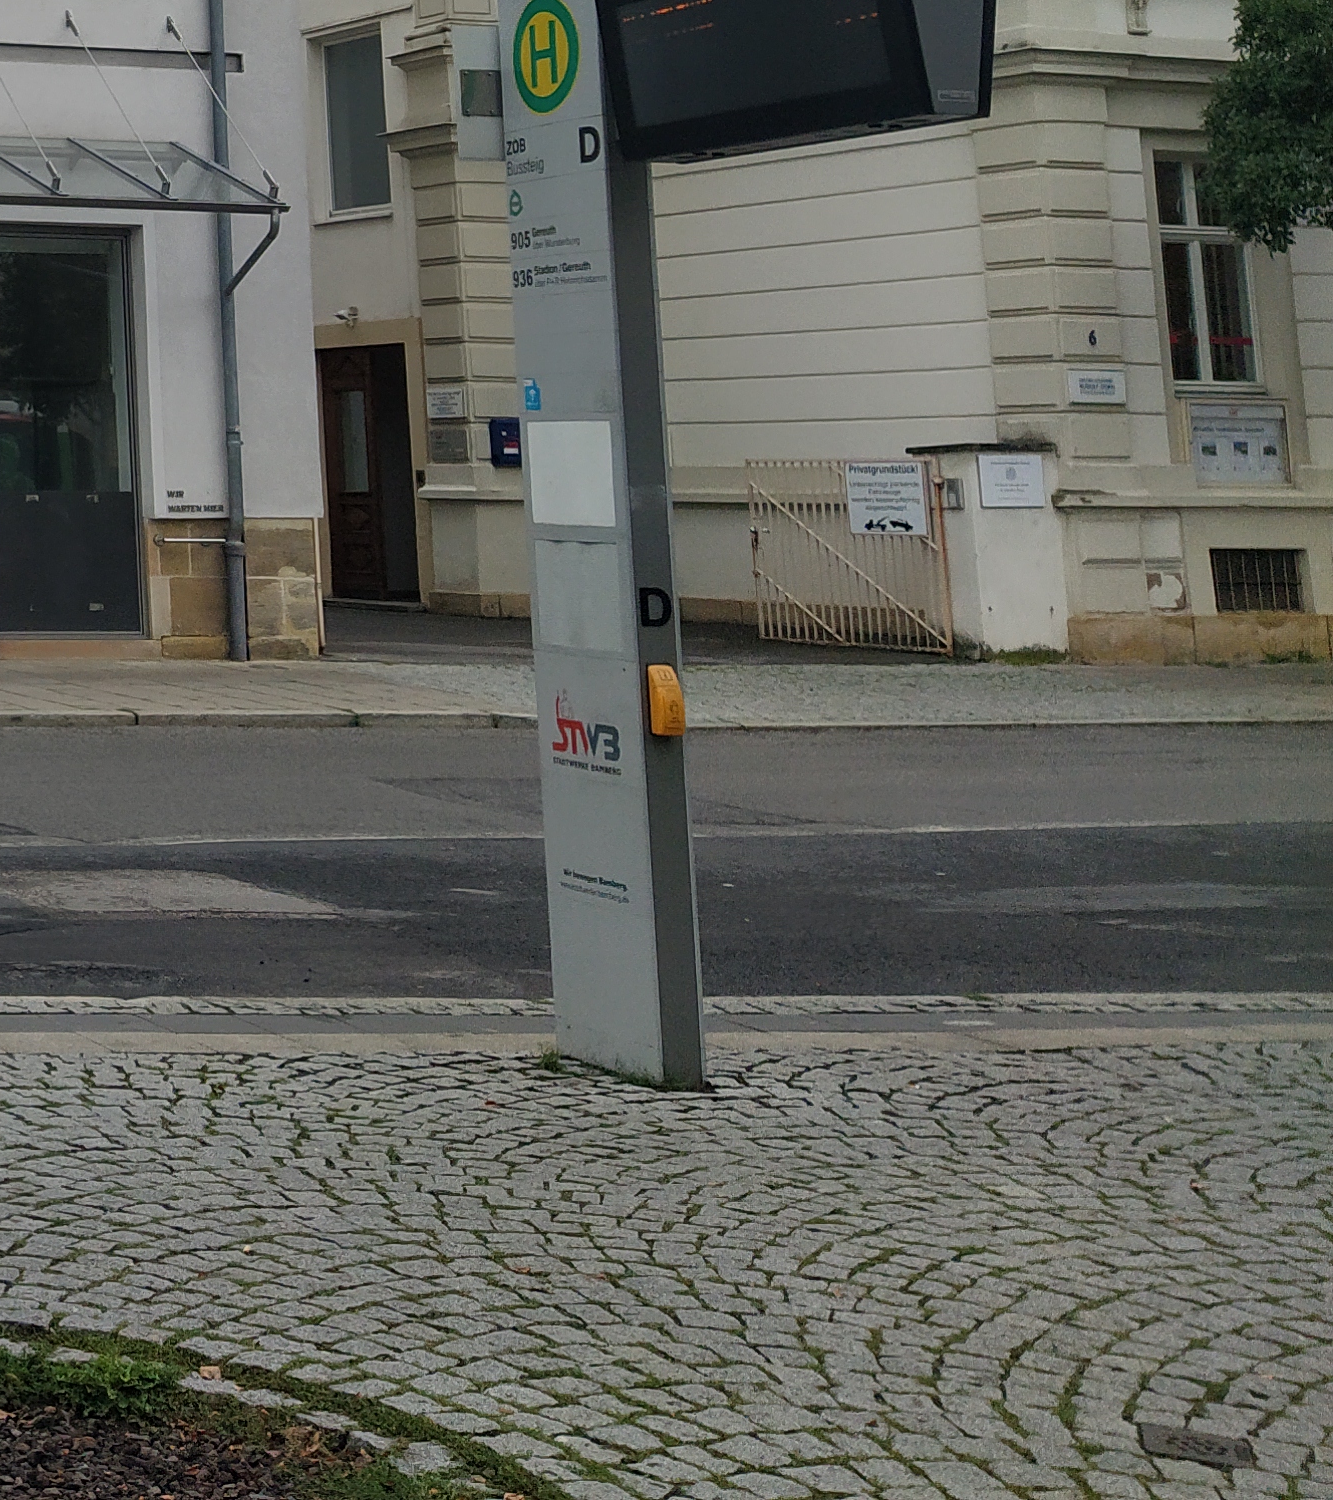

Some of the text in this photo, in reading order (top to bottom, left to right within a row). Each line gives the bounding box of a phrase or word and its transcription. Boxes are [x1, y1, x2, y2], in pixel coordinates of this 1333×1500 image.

[529, 20, 558, 88] H
[506, 137, 526, 156] ZOB
[578, 126, 601, 163] D
[507, 156, 544, 176] Bussteig
[511, 231, 531, 250] 905
[513, 269, 533, 288] 936
[1089, 329, 1097, 346] 6
[848, 463, 919, 476] Privatgrundstück!
[639, 587, 672, 627] D
